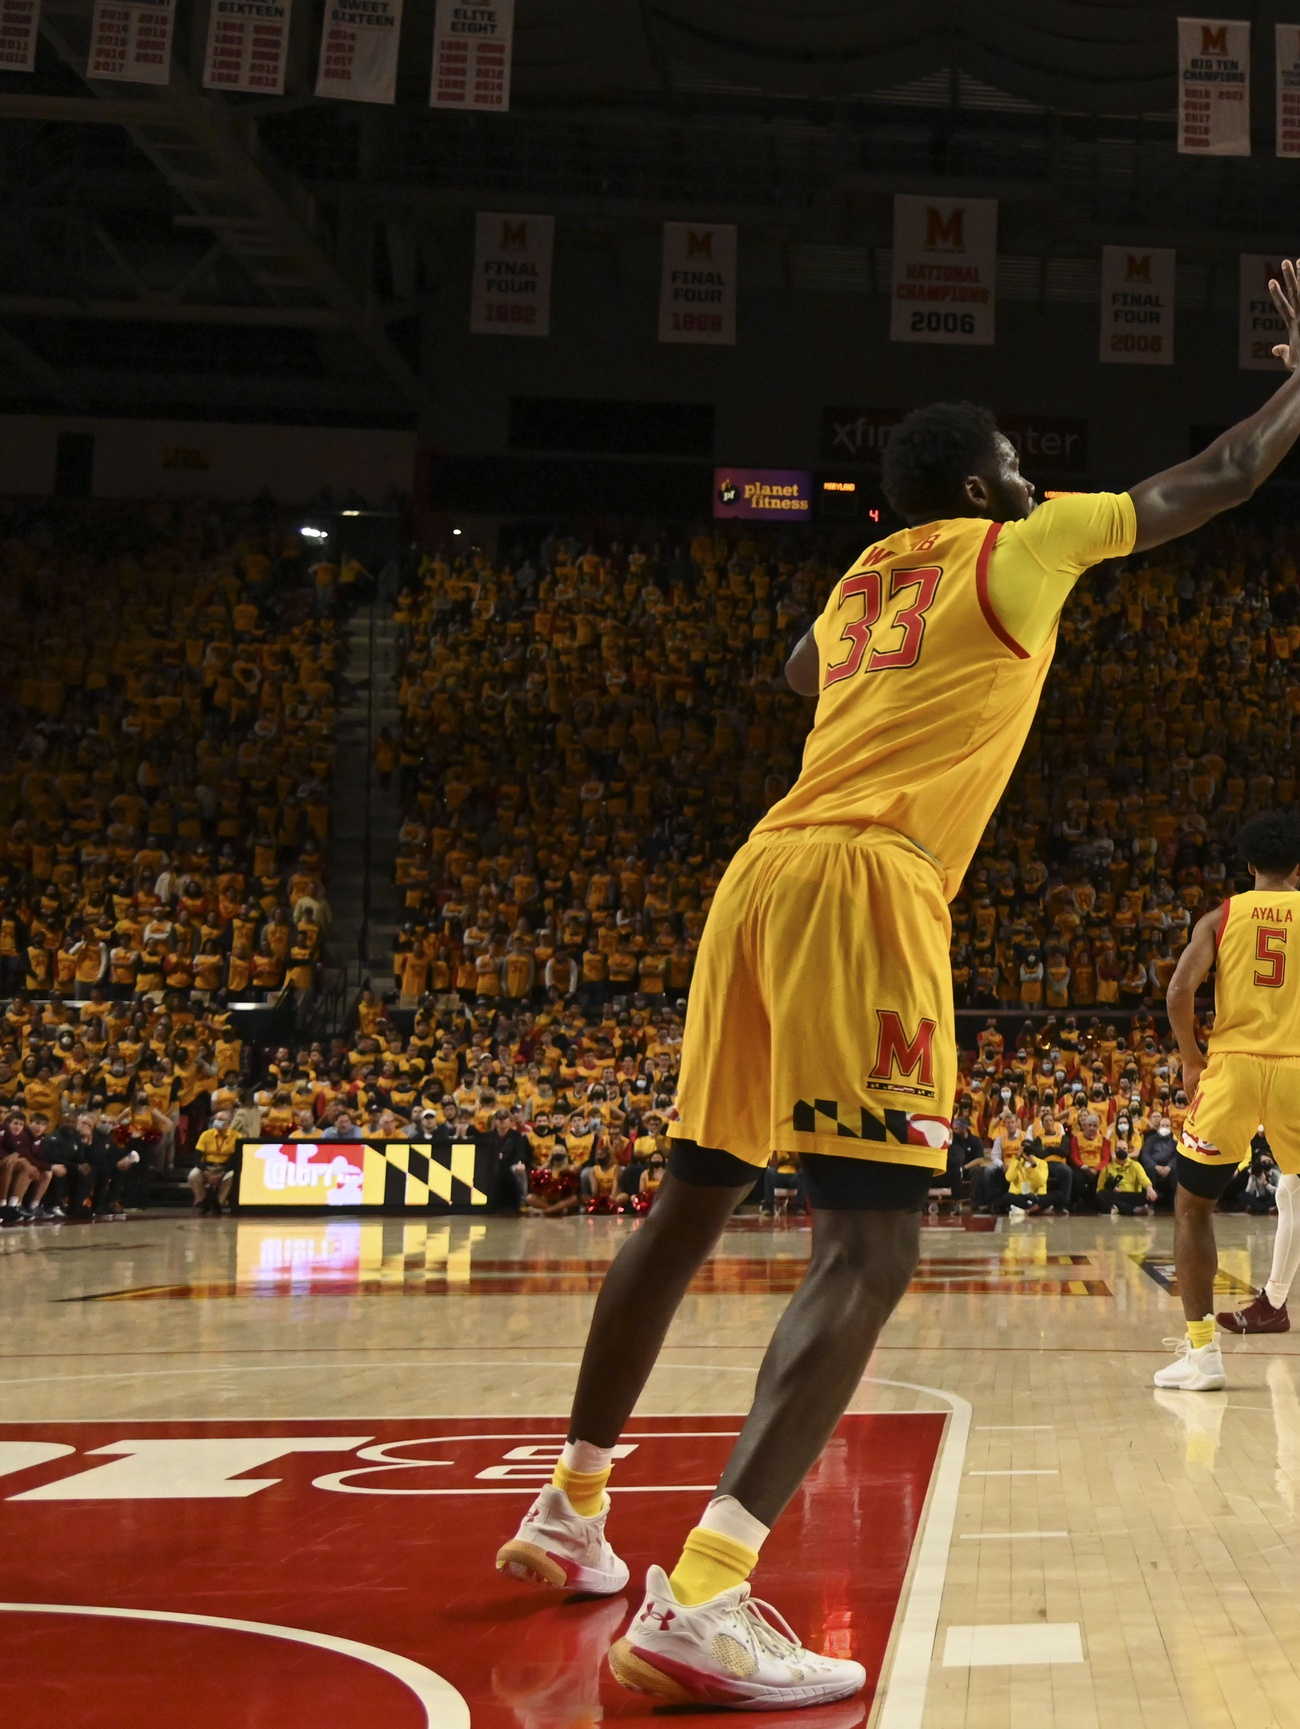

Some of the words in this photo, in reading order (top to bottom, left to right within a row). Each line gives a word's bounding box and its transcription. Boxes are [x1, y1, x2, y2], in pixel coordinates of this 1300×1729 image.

[218, 2, 285, 17] SIXTEEN
[331, 9, 395, 26] SIXTEEN
[454, 9, 495, 22] ELITE
[451, 21, 498, 34] EIGHT
[1201, 26, 1228, 55] M
[1191, 59, 1213, 70] BIG
[1216, 60, 1239, 70] TEN
[1184, 71, 1245, 83] CHAMPIONS
[501, 220, 527, 250] M
[924, 206, 967, 253] M
[686, 231, 712, 260] M
[484, 261, 539, 277] FINAL
[906, 264, 981, 283] NATIONAL
[1126, 255, 1151, 283] M
[486, 279, 536, 294] FOUR
[671, 271, 724, 286] FINAL
[674, 287, 721, 303] FOUR
[896, 284, 989, 304] CHAMPIONS
[1112, 292, 1164, 308] FINAL
[1250, 301, 1280, 314] FIN
[911, 311, 976, 335] 2006
[1114, 310, 1160, 324] FOUR
[1253, 318, 1287, 331] FOU
[744, 482, 800, 498] planet
[751, 496, 809, 511] fitness
[823, 566, 943, 690] 33
[1251, 907, 1293, 923] AYALA
[1254, 925, 1287, 988] 5
[868, 1008, 937, 1088] M
